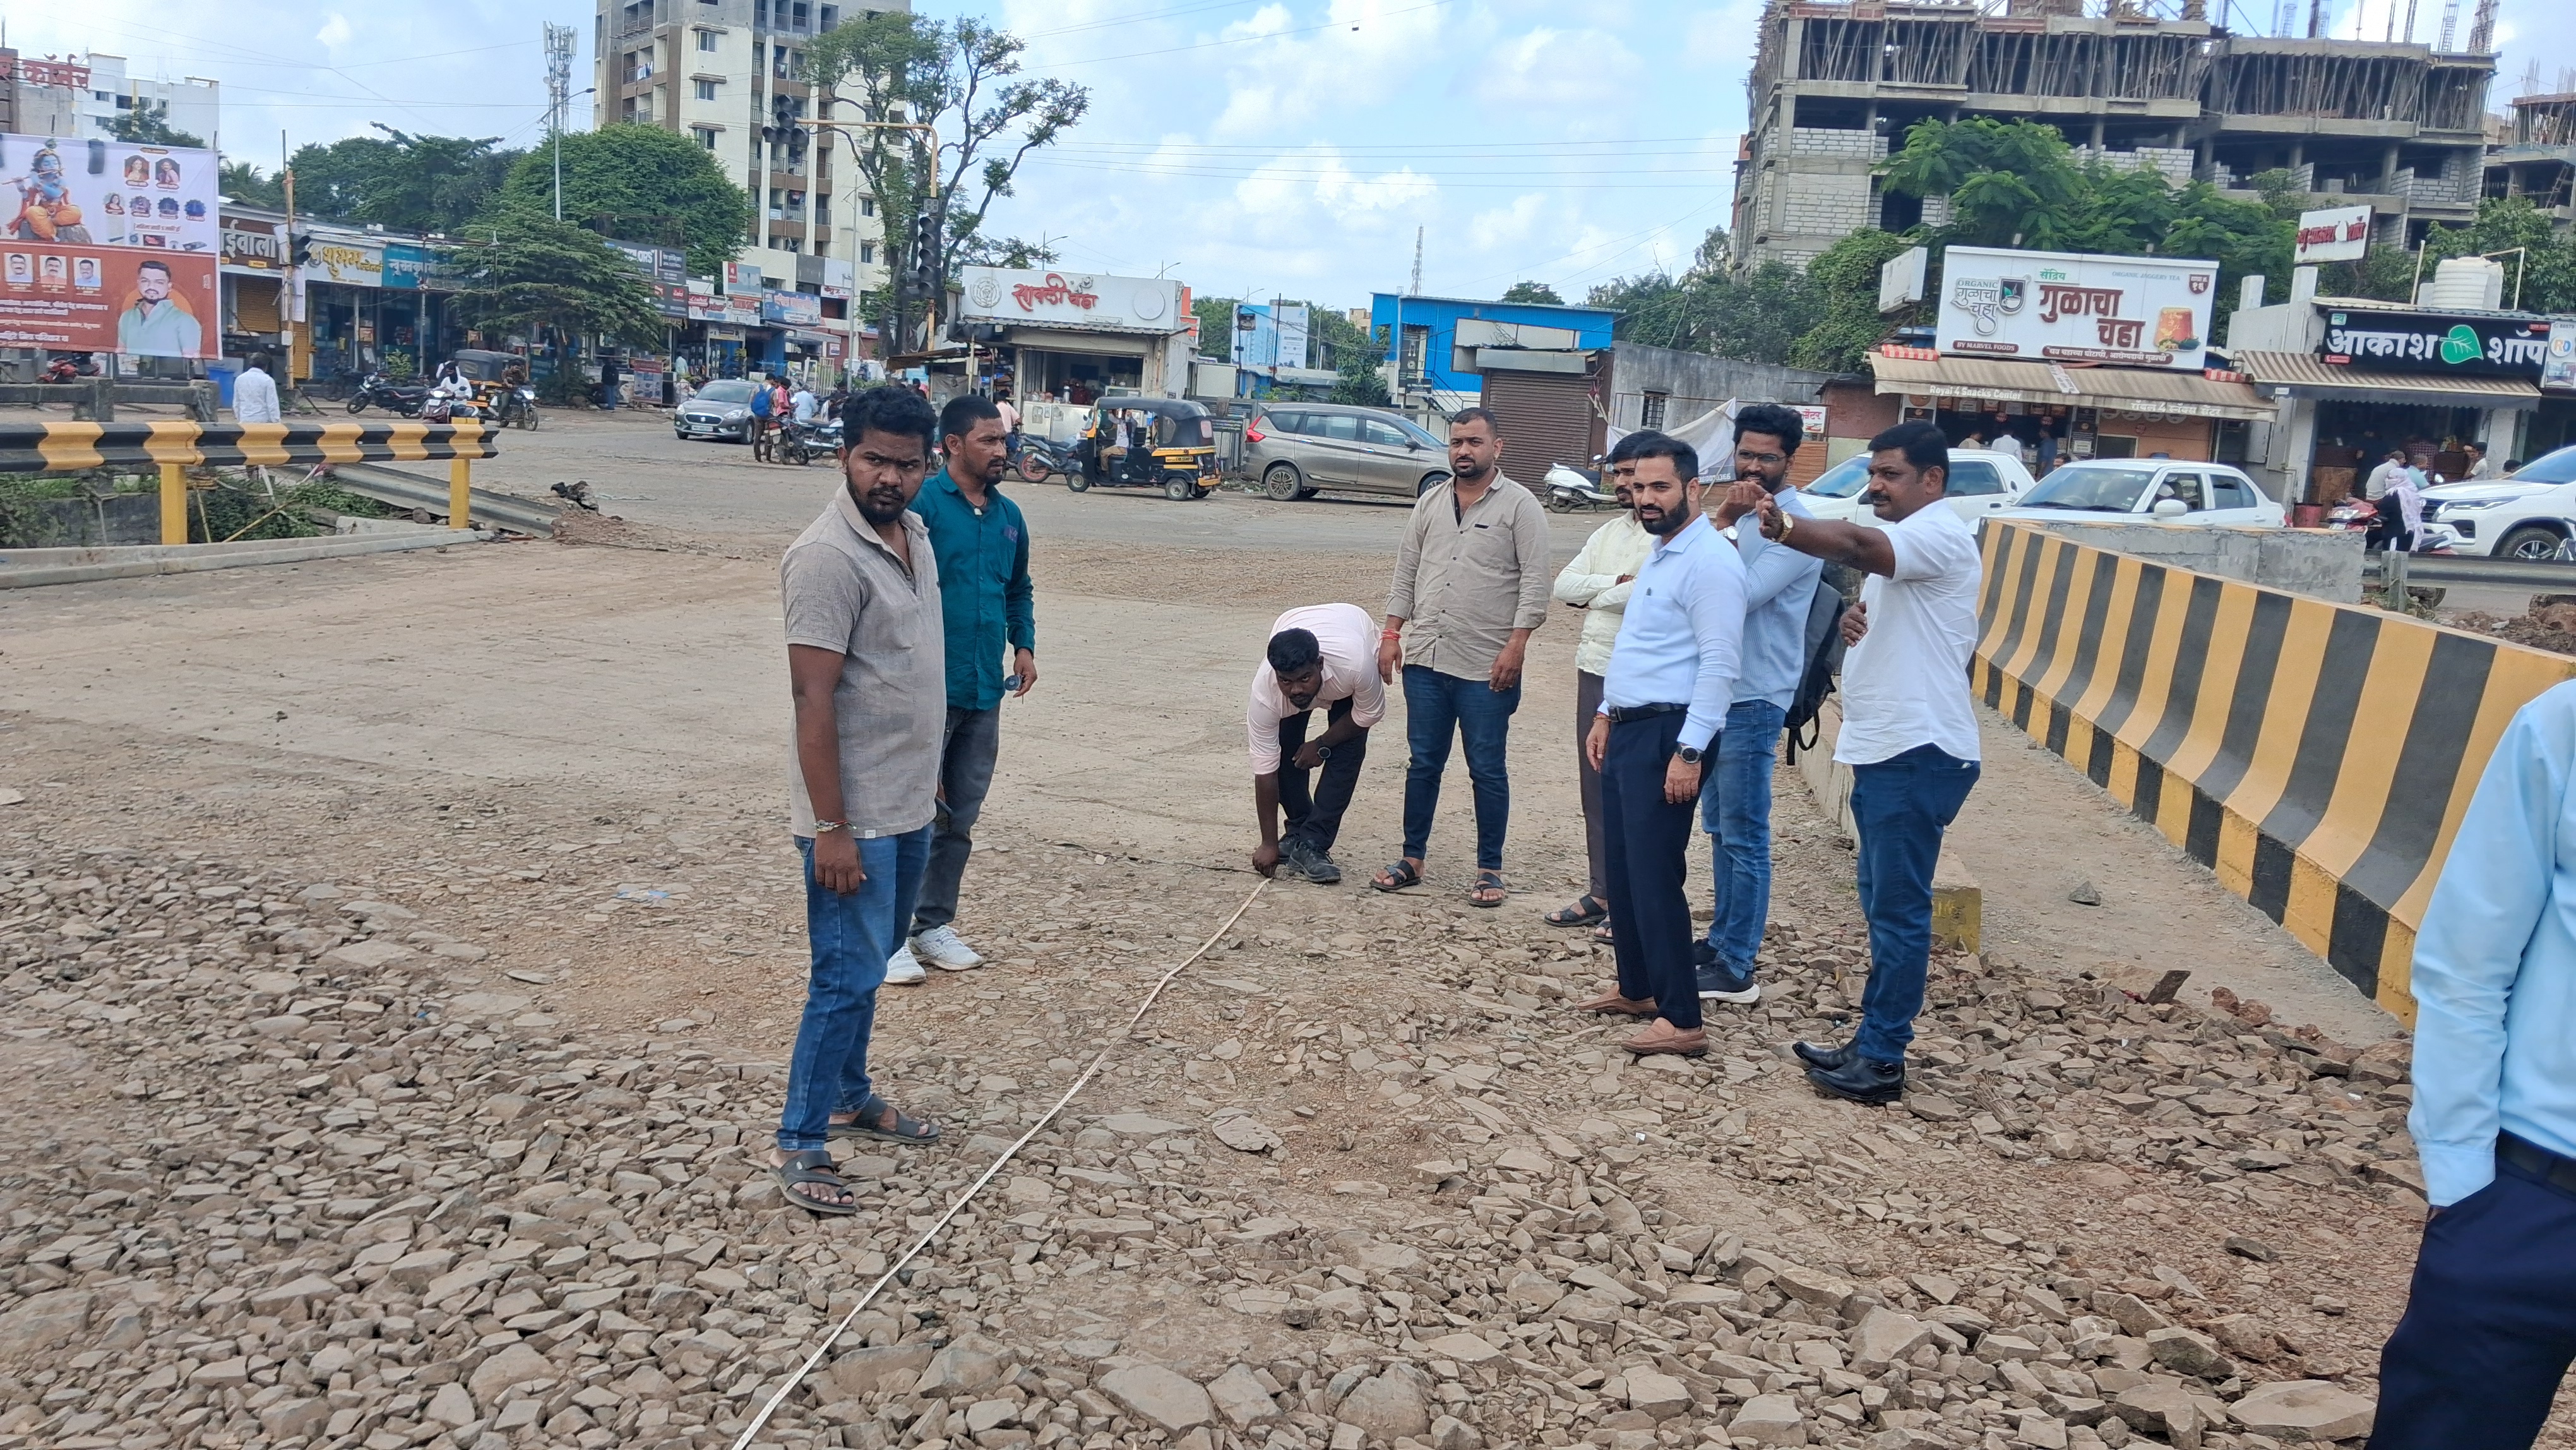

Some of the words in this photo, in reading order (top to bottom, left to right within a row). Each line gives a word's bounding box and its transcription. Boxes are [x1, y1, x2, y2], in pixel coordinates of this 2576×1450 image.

[2040, 268, 2066, 280] सेंद्रिय
[1957, 280, 1998, 288] ORGANIC
[1955, 287, 2000, 307] गुळाचा
[2039, 284, 2125, 323] गुळाचा
[2097, 318, 2147, 349] चहा
[2326, 329, 2439, 361] आकाश
[2487, 329, 2548, 365] शॉप
[2555, 339, 2573, 352] RD
[1929, 385, 1953, 397] Royal
[1953, 386, 1960, 395] 4
[1962, 387, 1991, 397] Snacks
[1993, 390, 2022, 400] Center
[2157, 402, 2166, 412] 4
